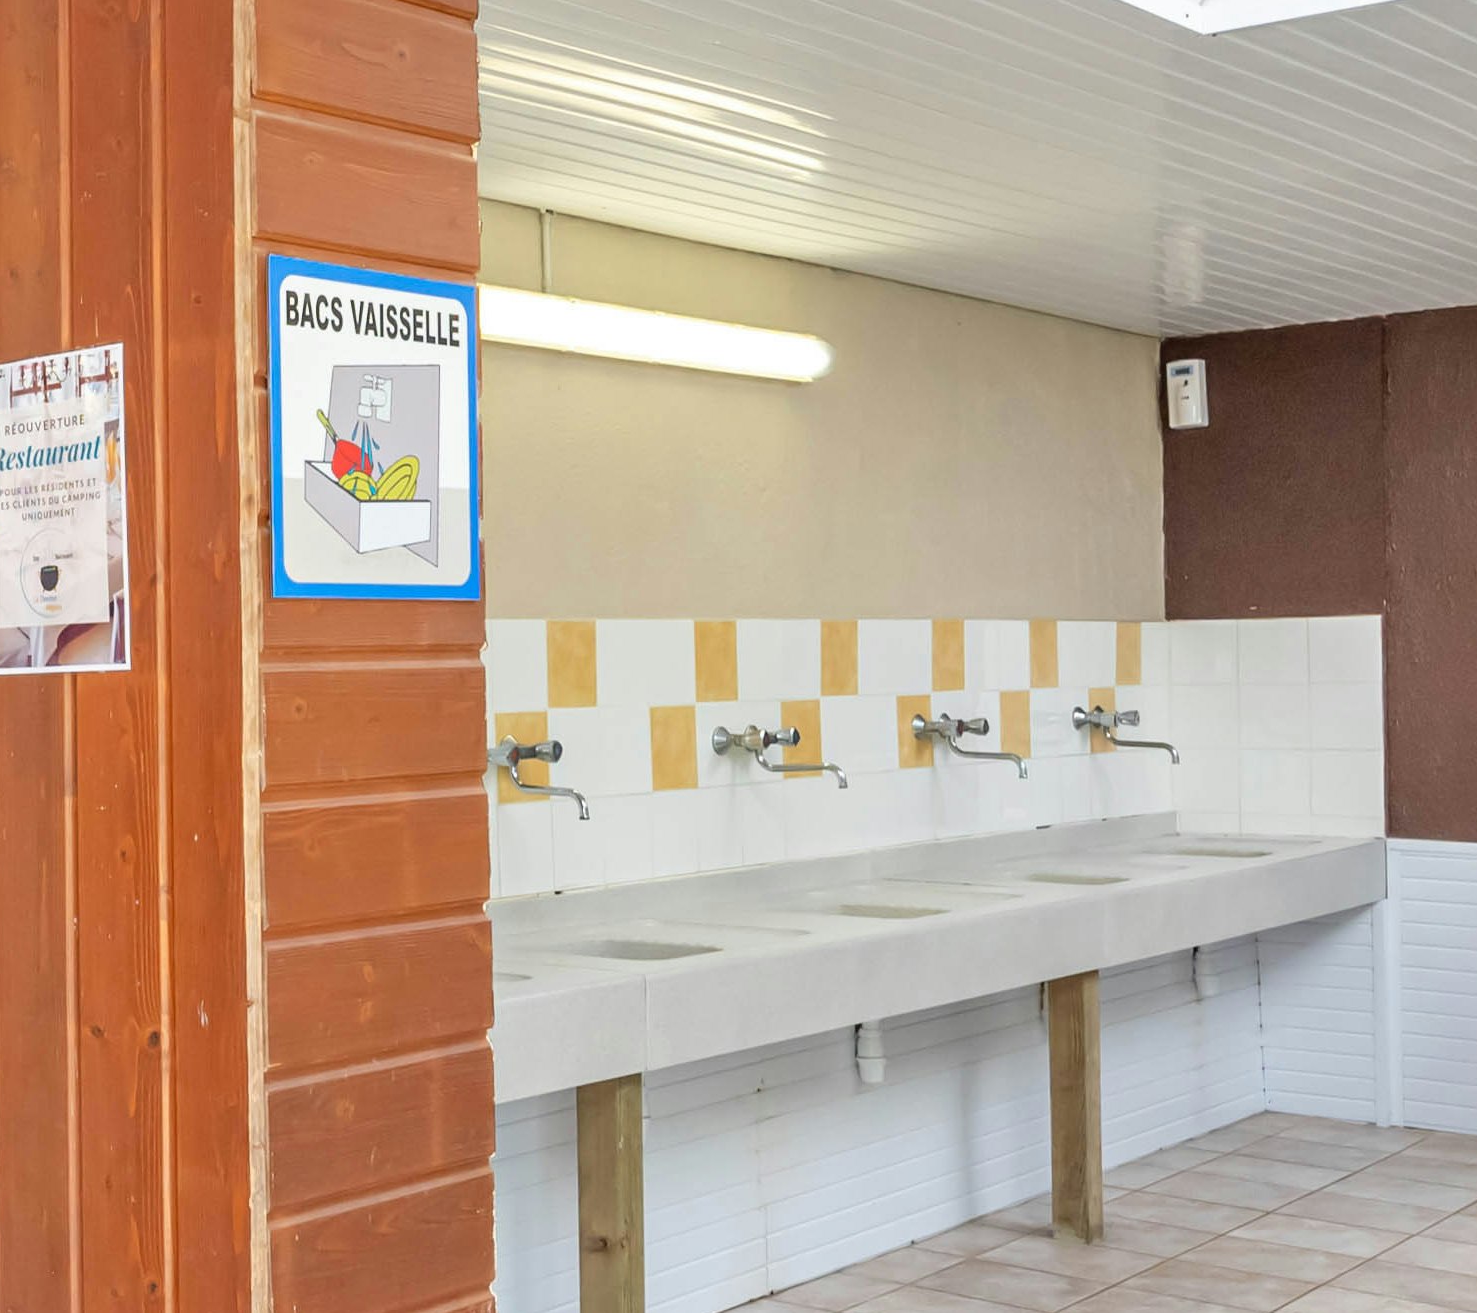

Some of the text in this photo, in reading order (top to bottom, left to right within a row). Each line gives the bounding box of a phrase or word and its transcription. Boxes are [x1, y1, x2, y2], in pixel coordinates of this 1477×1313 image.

[286, 290, 460, 347] BACS VAISSELLE
[5, 414, 85, 436] RÉOUVERTURE
[0, 488, 21, 496] POUR
[25, 486, 38, 495] LES
[87, 478, 96, 486] ET
[13, 498, 46, 509] CLIENTS
[48, 496, 59, 504] DU
[62, 492, 101, 504] CAMPING
[22, 508, 75, 521] UNIQUEMENT
